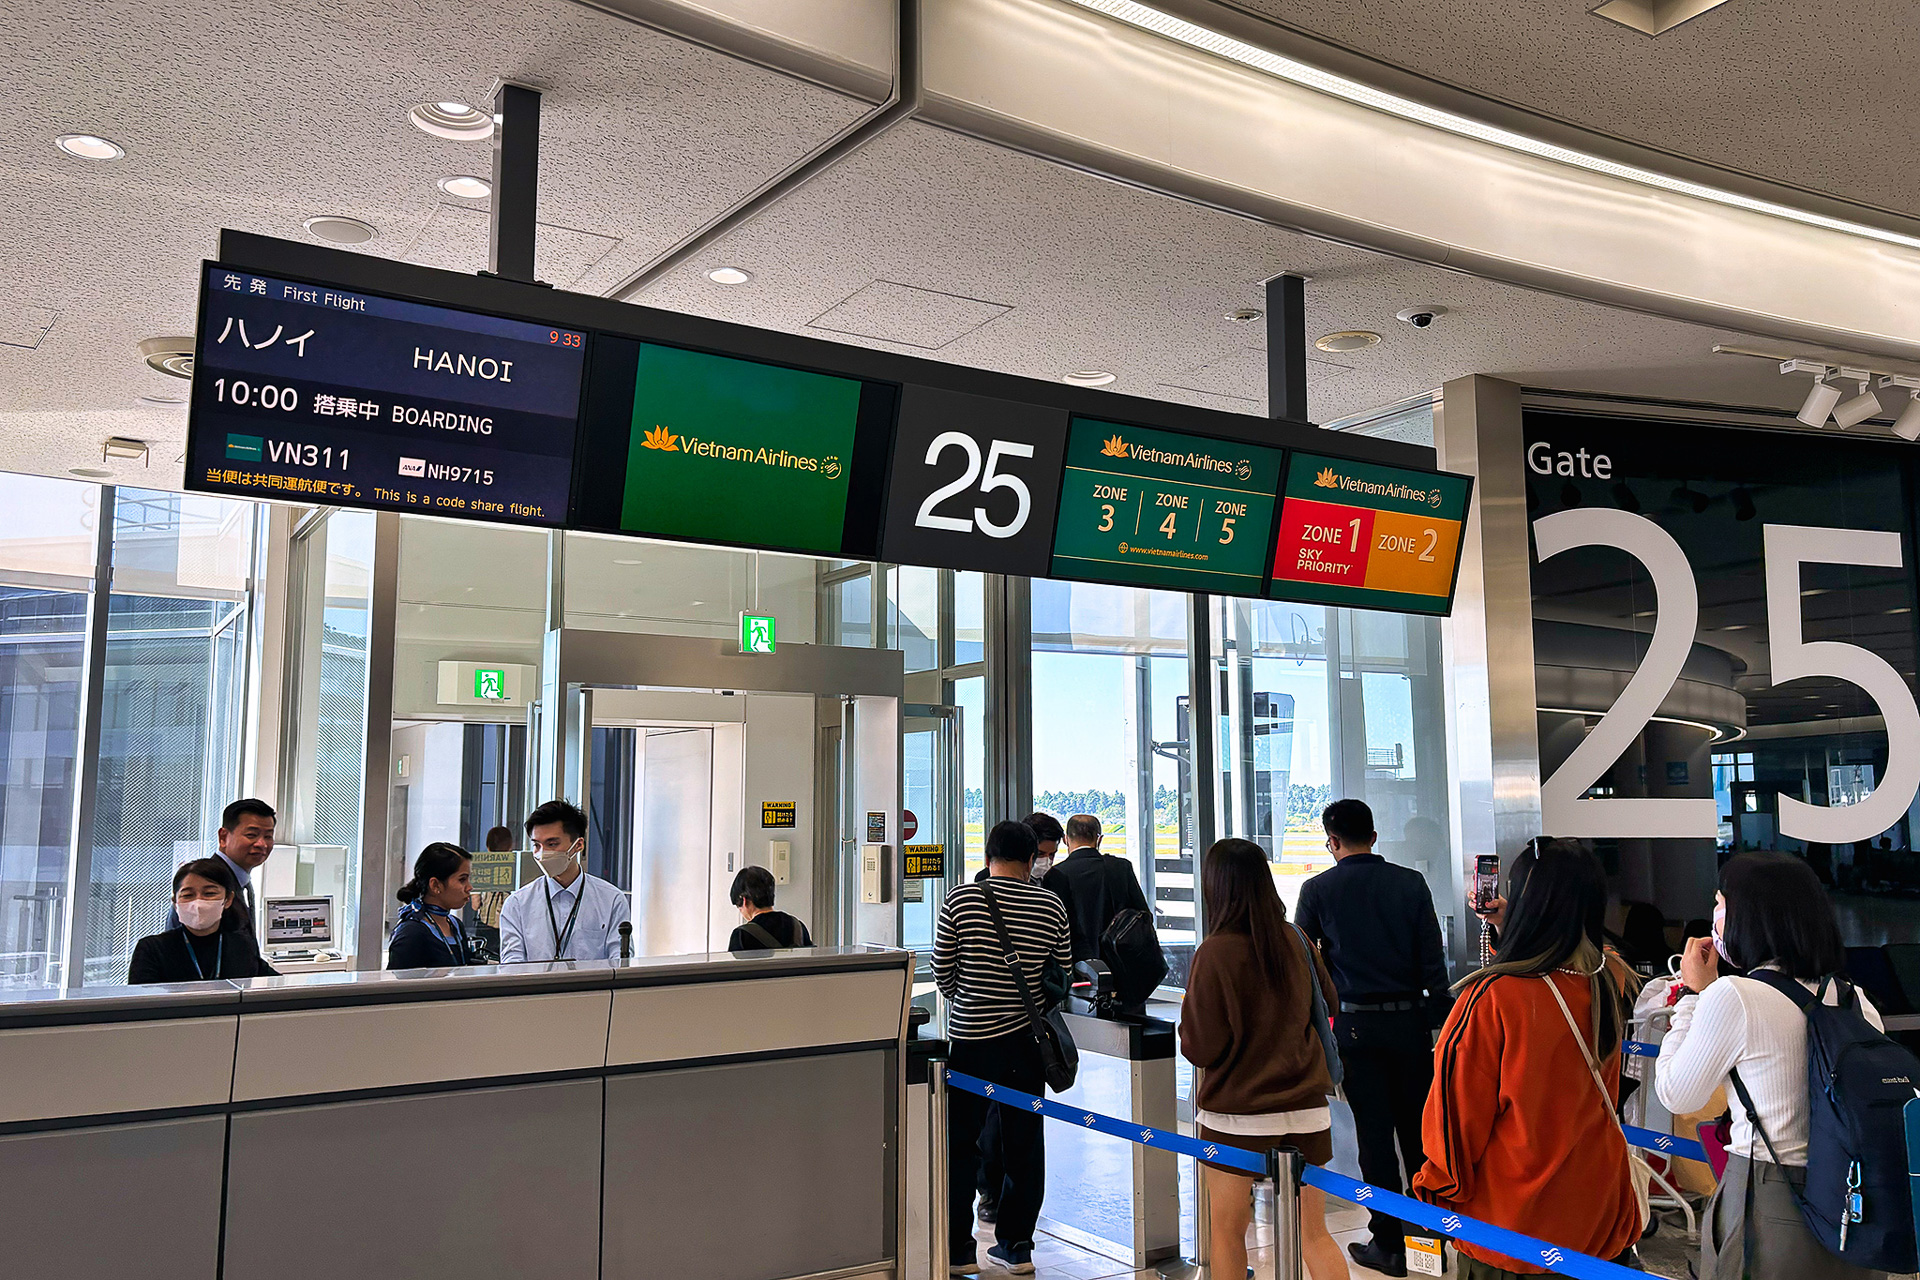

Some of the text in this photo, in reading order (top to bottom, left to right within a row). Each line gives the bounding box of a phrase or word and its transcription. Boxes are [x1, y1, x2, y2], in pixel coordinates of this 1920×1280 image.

[284, 286, 365, 311] First Flight
[218, 318, 314, 357] ハノイ
[414, 348, 512, 382] HANOI
[215, 379, 297, 411] 10:00
[314, 394, 379, 420] 搭乗中
[393, 406, 492, 434] BOARDING
[269, 440, 348, 470] VN311
[681, 436, 753, 462] Vietnam
[754, 448, 817, 471] Airlines
[1130, 444, 1184, 466] Vietnam
[1184, 453, 1232, 473] Airlines
[1528, 442, 1611, 479] Gate
[206, 468, 361, 498] 当便は共同運航便です。
[428, 464, 493, 485] NH9715
[915, 432, 1034, 538] 25
[1339, 475, 1385, 495] Vietnam
[1384, 482, 1426, 502] Airlines
[374, 488, 546, 518] This is a code share flight.
[1093, 485, 1127, 501] ZONE
[1156, 493, 1188, 508] ZONE
[1097, 504, 1115, 532] 3
[1214, 500, 1248, 517] ZONE
[1159, 512, 1177, 540] 4
[1218, 518, 1236, 546] 5
[1302, 517, 1361, 553] ZONE 1
[1129, 547, 1209, 561] www.vietnamairlines.com
[1298, 547, 1323, 560] SKY
[1378, 528, 1438, 562] ZONE 2
[1297, 559, 1350, 574] PRIORITY
[1533, 507, 1920, 844] 25
